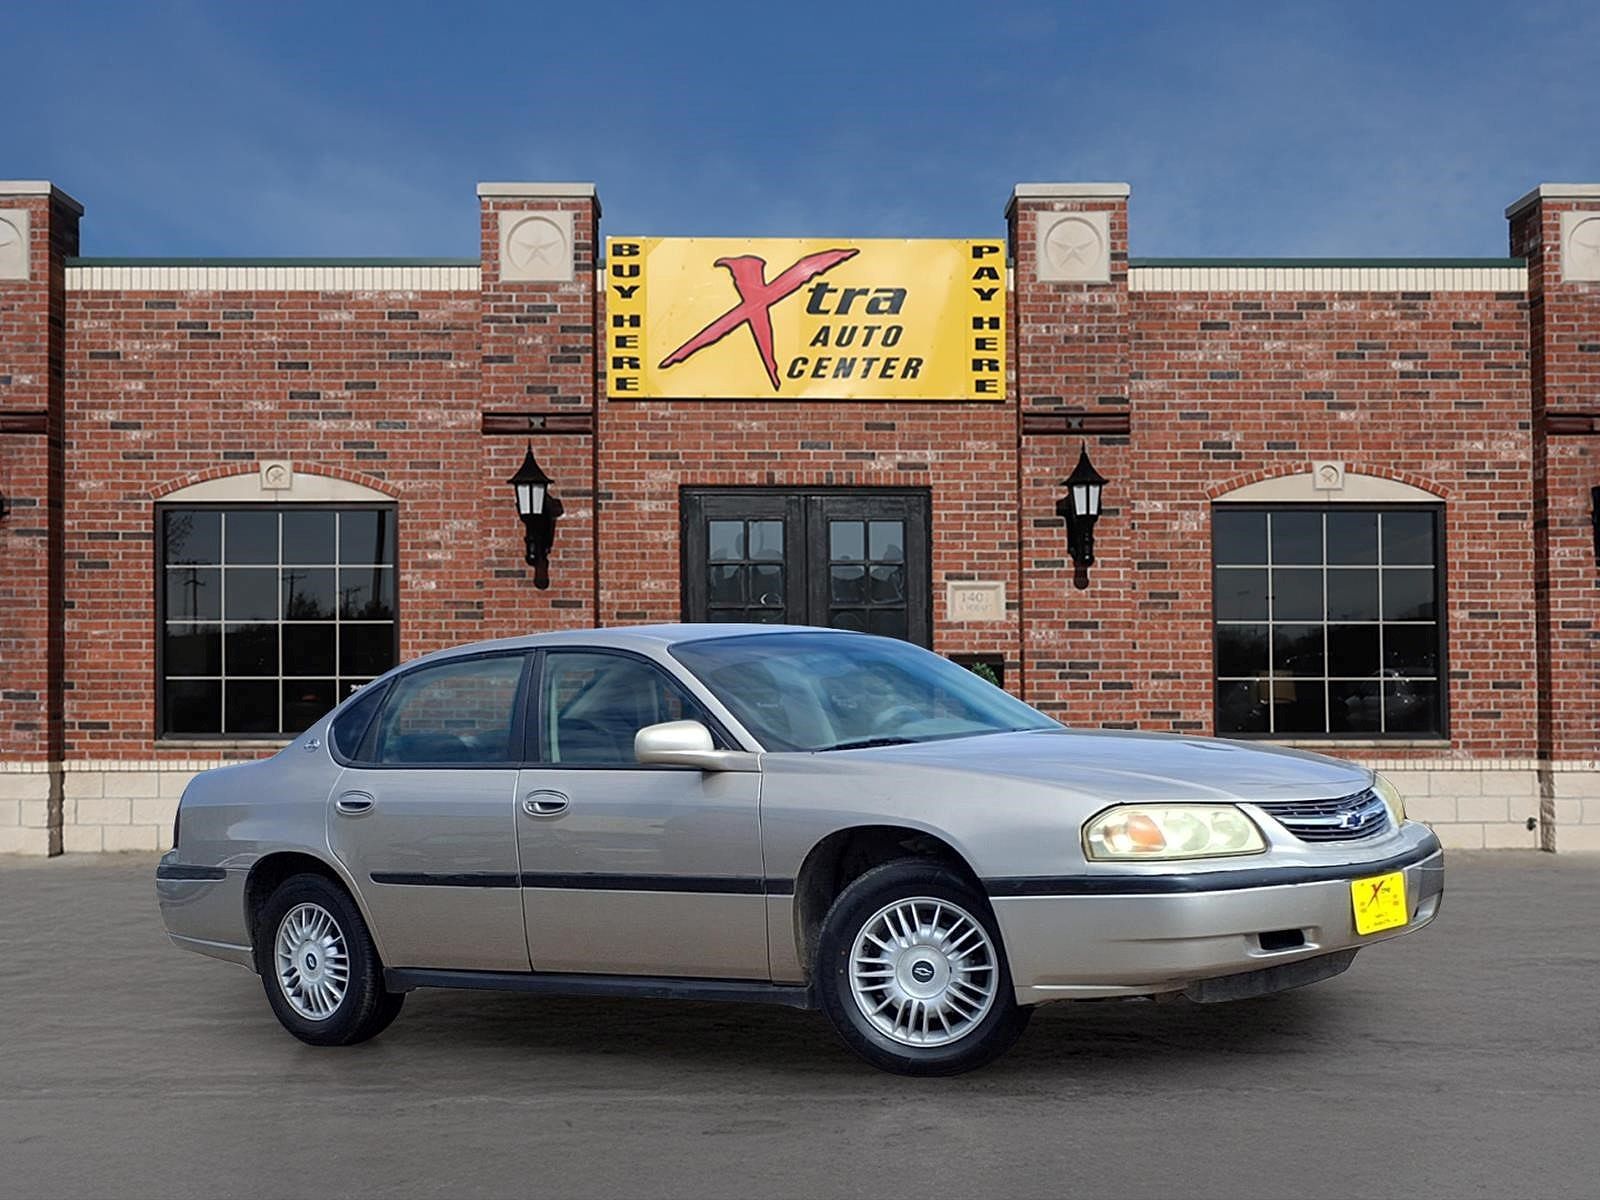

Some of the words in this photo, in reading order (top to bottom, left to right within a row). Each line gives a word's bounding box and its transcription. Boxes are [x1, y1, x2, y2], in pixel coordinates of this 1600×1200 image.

[612, 243, 640, 299] BUY
[972, 245, 1000, 301] PAY
[612, 314, 641, 391] HERE
[809, 325, 903, 348] AUTO
[972, 316, 1000, 393] HERE
[786, 356, 924, 379] CENTER
